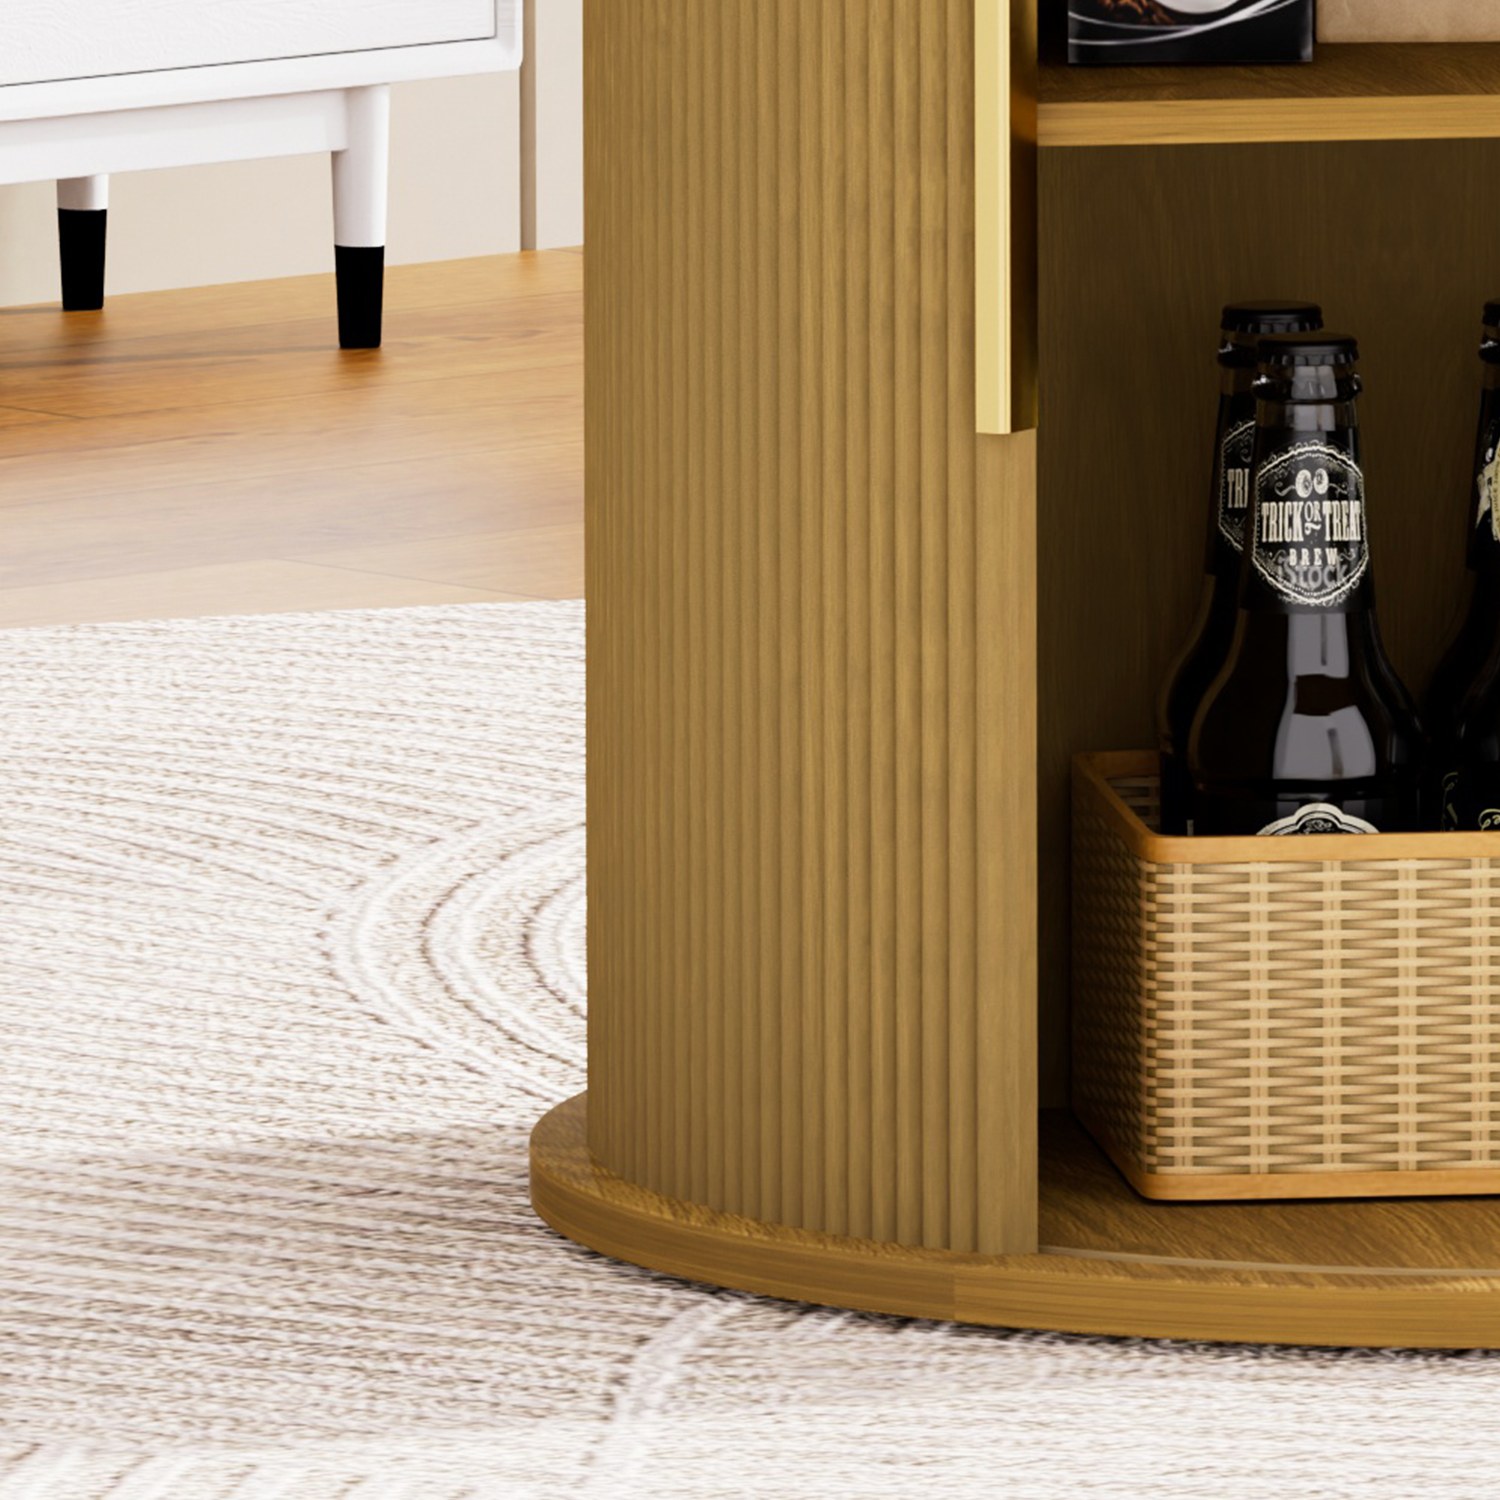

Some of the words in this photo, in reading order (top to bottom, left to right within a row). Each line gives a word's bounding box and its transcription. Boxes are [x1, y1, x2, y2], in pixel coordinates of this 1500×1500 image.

[1227, 468, 1249, 508] TRI
[1261, 501, 1304, 542] TRICK
[1304, 500, 1322, 522] OR
[1322, 500, 1361, 542] TREAT
[1289, 547, 1338, 566] BREW
